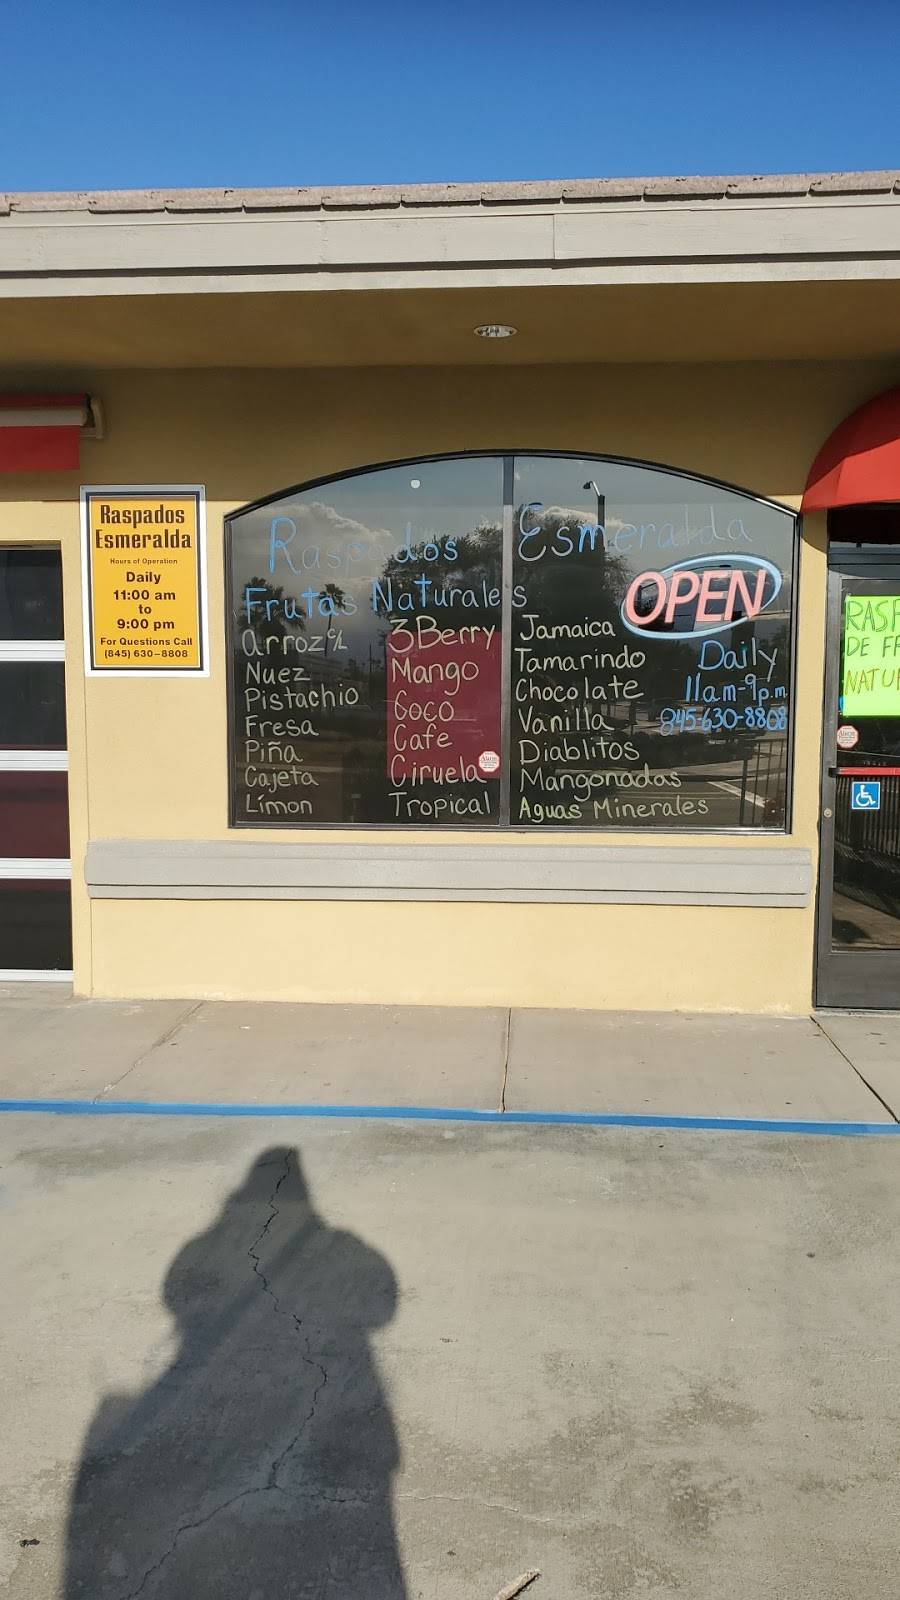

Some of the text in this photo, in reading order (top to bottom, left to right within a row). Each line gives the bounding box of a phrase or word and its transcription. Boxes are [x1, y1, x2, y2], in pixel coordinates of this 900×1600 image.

[100, 504, 185, 528] Raspados
[95, 529, 192, 549] Esmeralda
[518, 502, 753, 562] Esmeralda
[268, 516, 459, 577] Raspados
[126, 571, 161, 584] Daily
[113, 590, 176, 600] 11:00 am
[243, 585, 358, 624] Frutas
[625, 569, 767, 625] OPEN
[138, 604, 152, 614] to
[117, 619, 175, 631] 9:00 pm
[520, 614, 616, 641] Jamaica
[100, 637, 193, 646] For Questions Call
[104, 649, 131, 659] (845)
[847, 636, 870, 656] DE
[514, 645, 646, 673] Tamarindo
[698, 637, 778, 682] Daily
[245, 662, 311, 685] Nuez
[391, 657, 479, 696] Mango
[845, 668, 900, 695] NATU
[244, 684, 359, 712] Pistachio
[515, 675, 644, 702] Chocolate
[394, 690, 455, 722] Coco
[245, 715, 319, 738] Fresa
[518, 706, 615, 734] Vanilla
[660, 706, 787, 736] 845-630-8808
[394, 723, 453, 752] Cafe
[519, 736, 640, 765] Diablitos
[245, 740, 303, 763] Piña
[245, 765, 319, 793] Cajeta
[390, 754, 487, 788] Ciruela
[520, 763, 682, 802] Mangonadas
[388, 791, 491, 818] Tropical
[519, 796, 709, 823] Aguas Minerales
